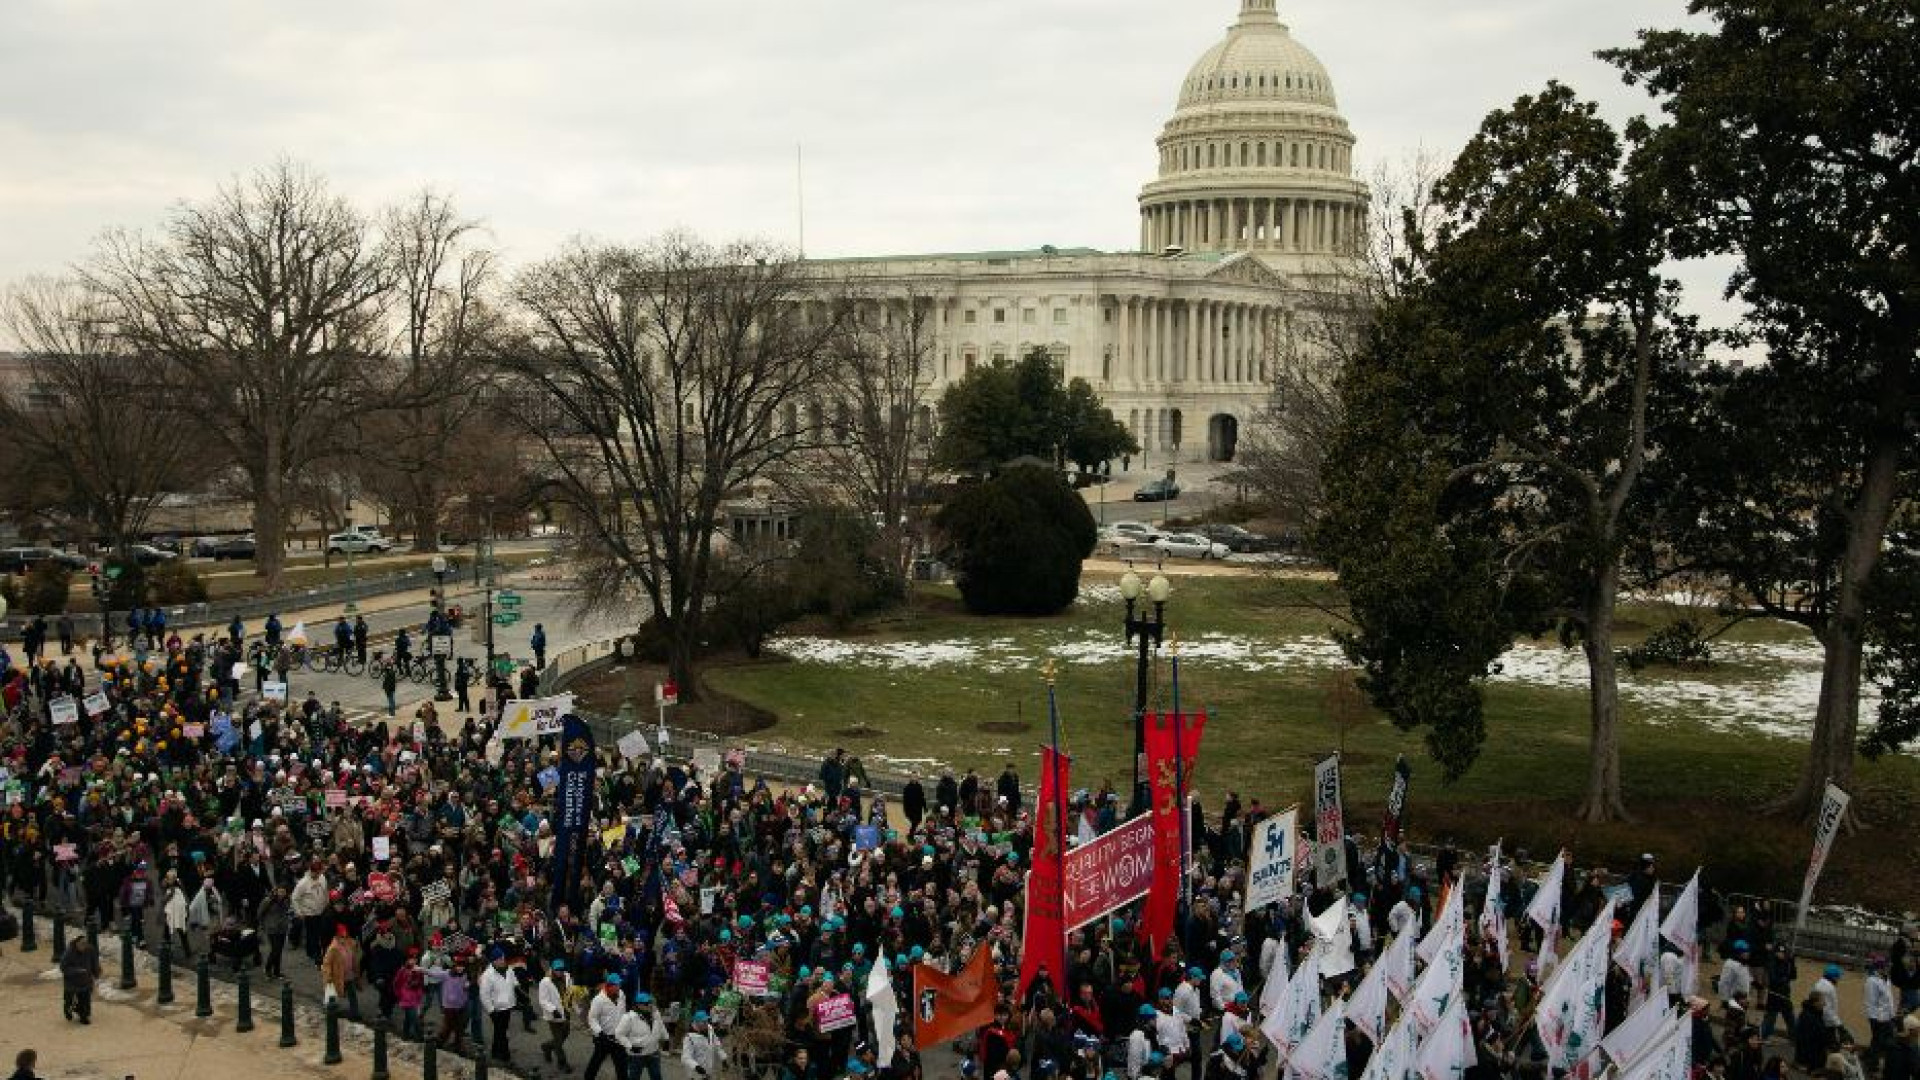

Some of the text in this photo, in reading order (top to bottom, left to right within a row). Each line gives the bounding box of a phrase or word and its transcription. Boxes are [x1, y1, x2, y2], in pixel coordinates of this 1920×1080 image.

[564, 771, 577, 827] Columbus
[1065, 841, 1117, 882] QUALITY
[1121, 825, 1155, 853] BEGIN
[1101, 846, 1155, 892] WOM
